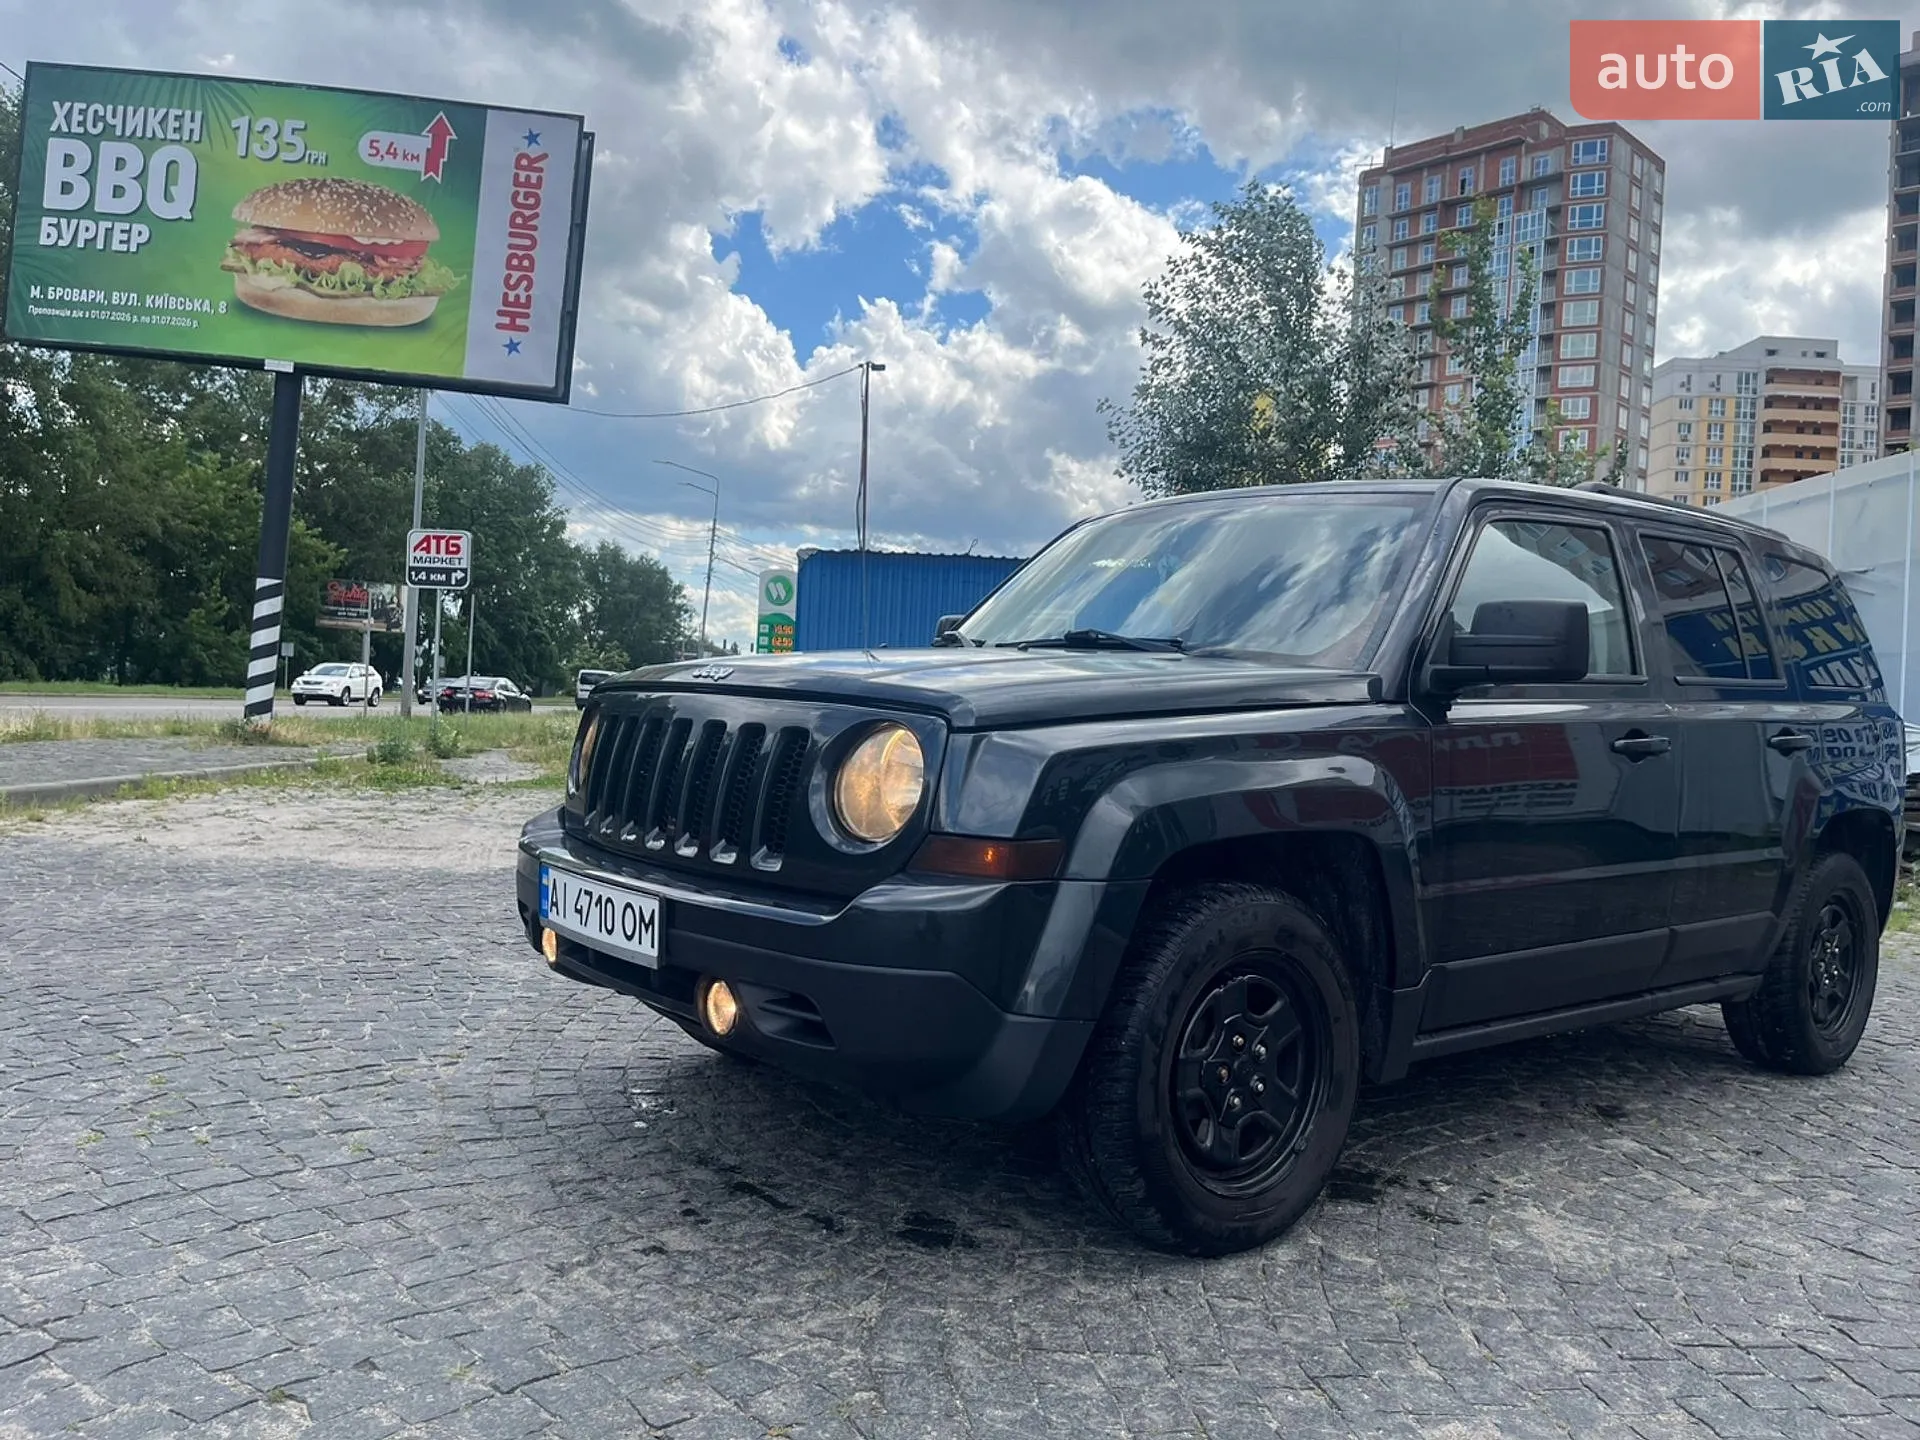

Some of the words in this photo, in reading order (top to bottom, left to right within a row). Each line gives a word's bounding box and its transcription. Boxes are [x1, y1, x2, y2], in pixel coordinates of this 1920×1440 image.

[50, 100, 203, 142] ХЕСЧИКЕН
[231, 115, 306, 163] 135
[368, 138, 399, 162] 5,4
[42, 136, 199, 221] BBQ
[39, 216, 151, 252] БУРГЕР
[495, 151, 550, 333] HESBURGER
[30, 285, 44, 299] М.
[47, 286, 108, 306] БРОВАРИ,
[111, 290, 141, 306] ВУЛ.
[145, 293, 215, 315] КИЇВСЬКА,
[218, 300, 228, 314] 8
[413, 534, 464, 556] АТБ
[413, 556, 464, 566] МАРКЕТ
[411, 570, 427, 581] 1,4
[549, 878, 567, 919] AI
[574, 887, 615, 936] 4710
[621, 901, 656, 949] OM
